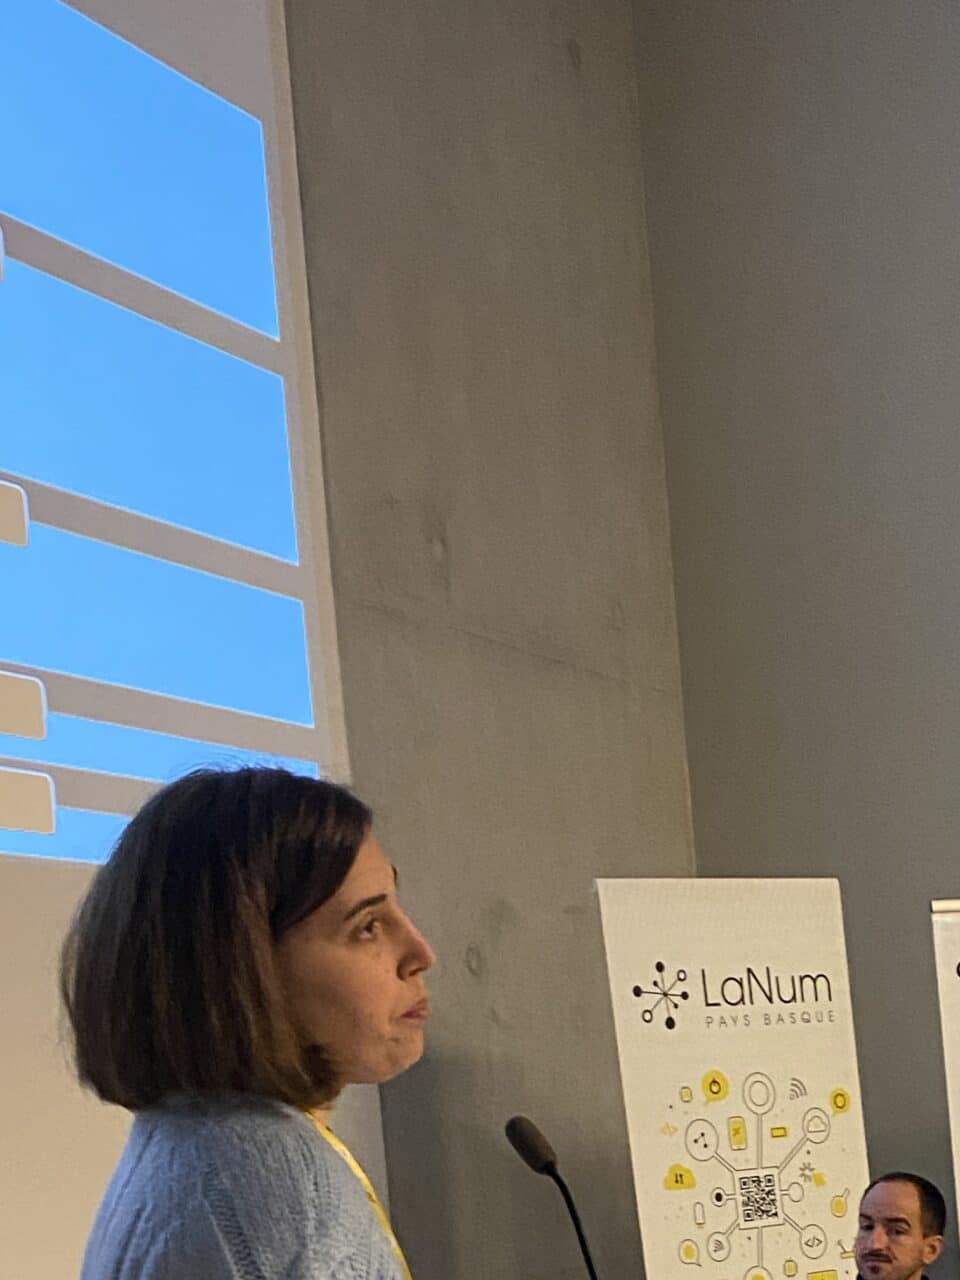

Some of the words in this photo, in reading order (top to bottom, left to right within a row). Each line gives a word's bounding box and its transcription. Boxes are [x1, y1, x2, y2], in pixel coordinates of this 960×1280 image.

[701, 965, 833, 1008] LaNum
[704, 1013, 751, 1028] PAYS
[763, 1010, 837, 1026] BASQUE
